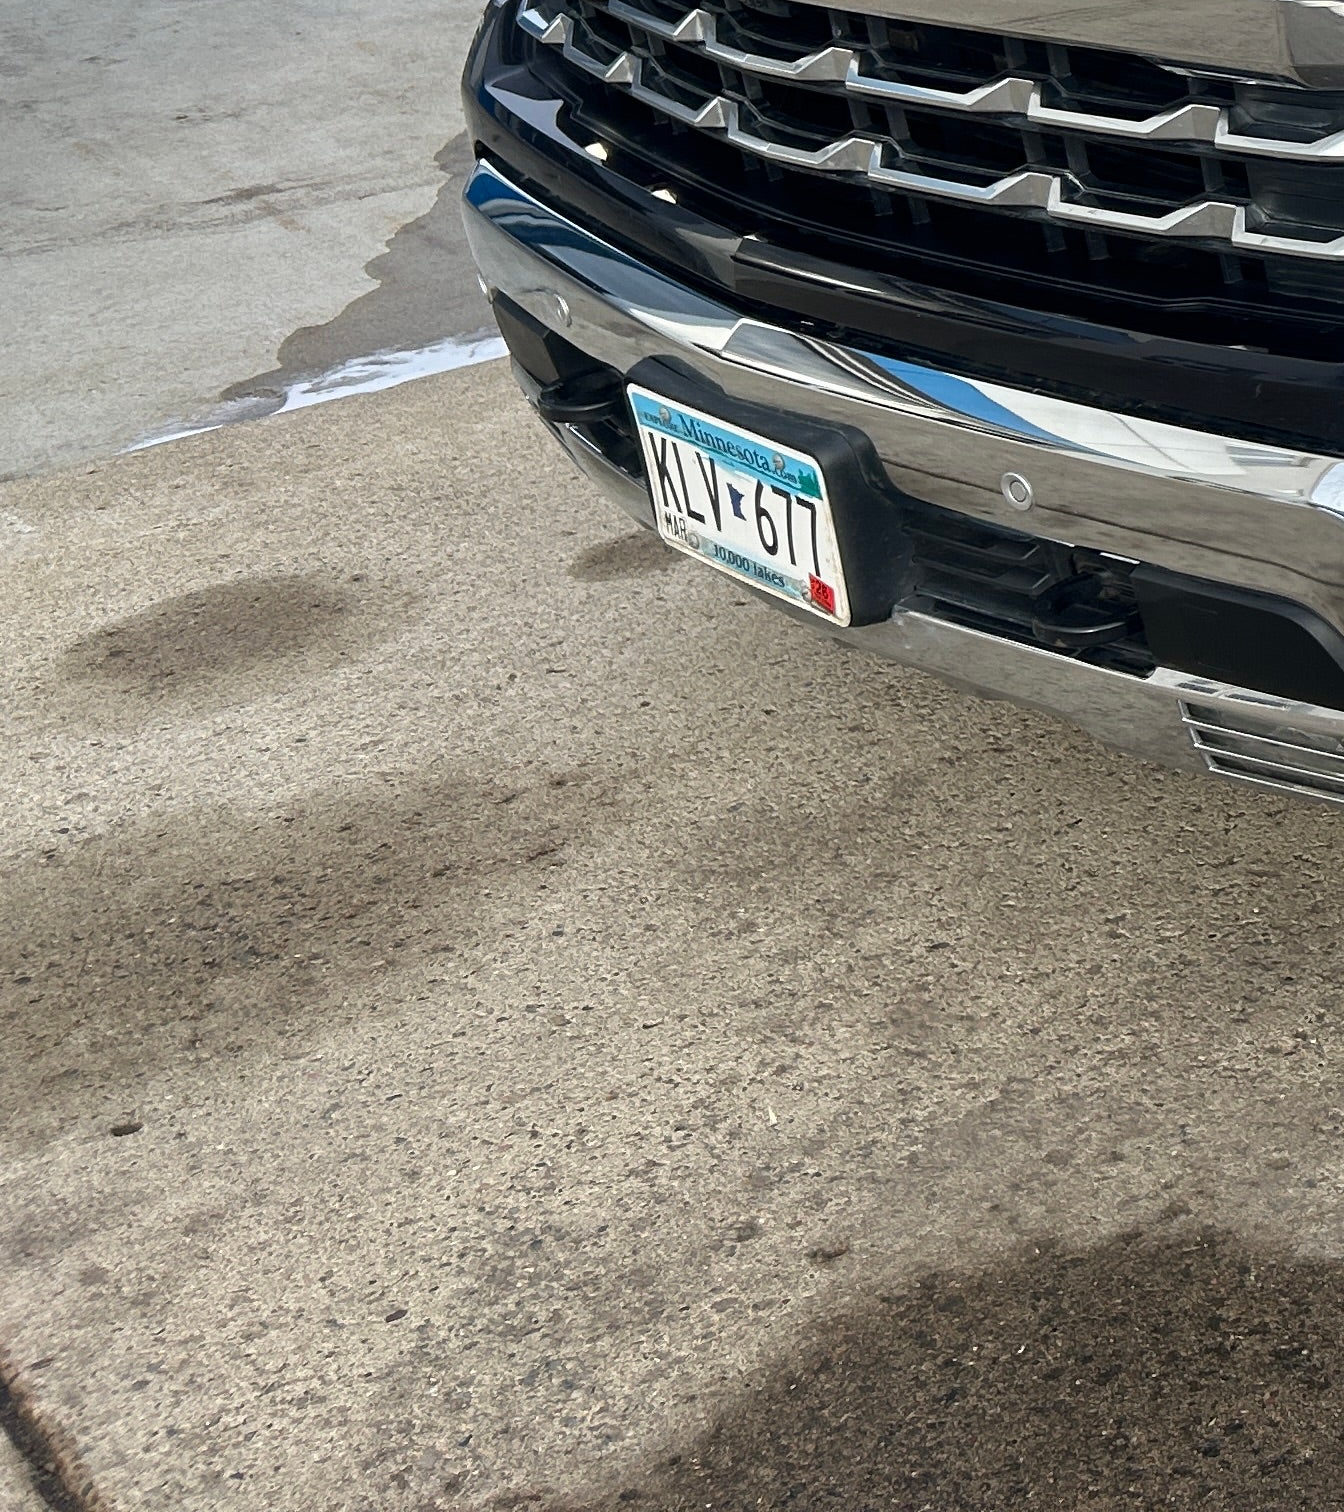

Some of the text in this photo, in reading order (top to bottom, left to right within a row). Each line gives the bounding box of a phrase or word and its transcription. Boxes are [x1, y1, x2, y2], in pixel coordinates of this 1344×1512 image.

[649, 431, 821, 578] KLV 677
[664, 510, 688, 542] MAR
[714, 544, 785, 587] 10,000 lakes
